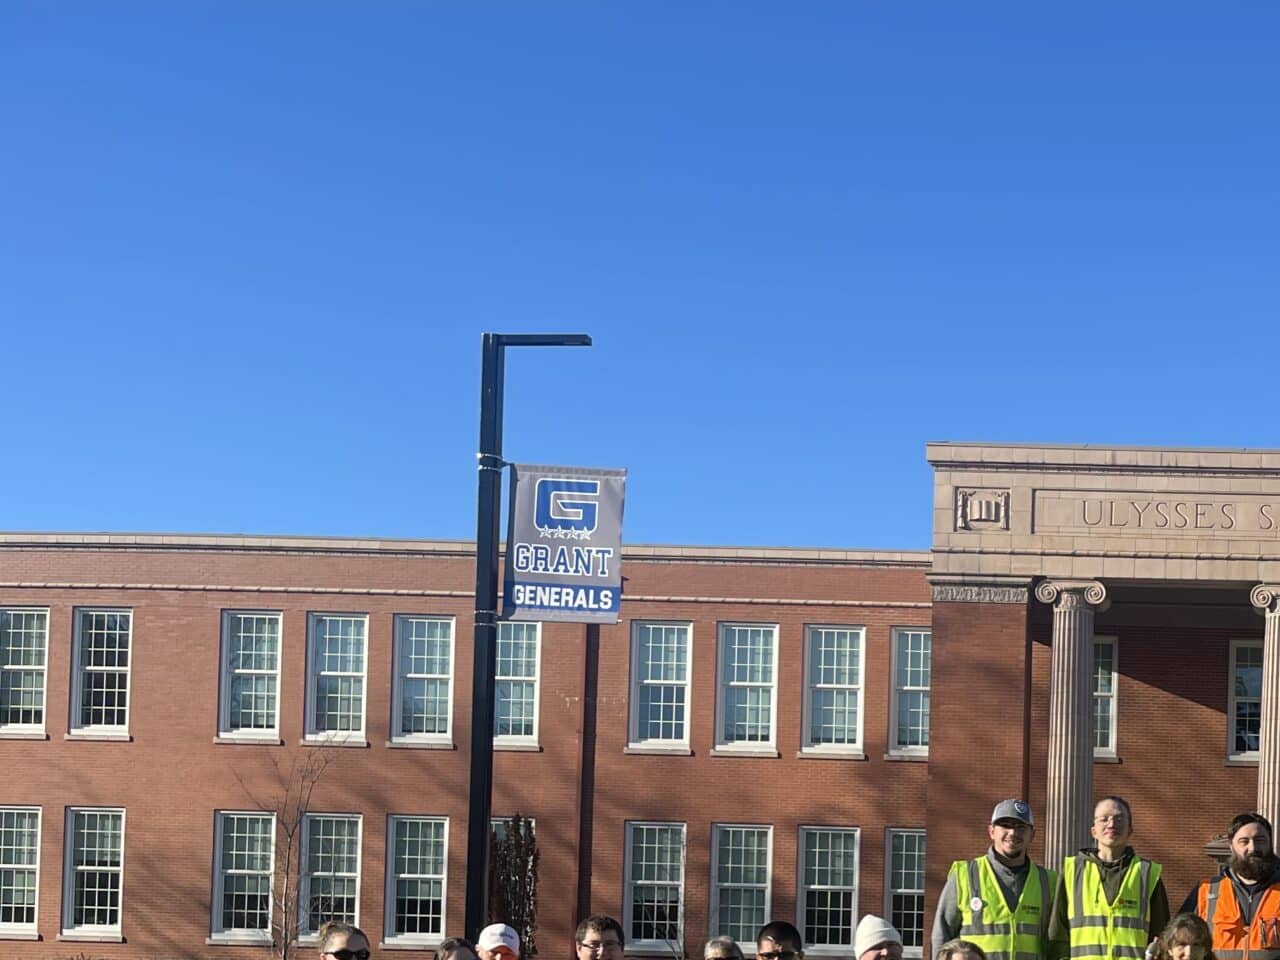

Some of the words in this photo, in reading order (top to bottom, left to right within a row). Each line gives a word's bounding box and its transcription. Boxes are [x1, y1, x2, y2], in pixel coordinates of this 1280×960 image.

[1082, 500, 1236, 530] ULYSSES
[513, 543, 613, 577] GRANT
[513, 585, 613, 610] GENERALS
